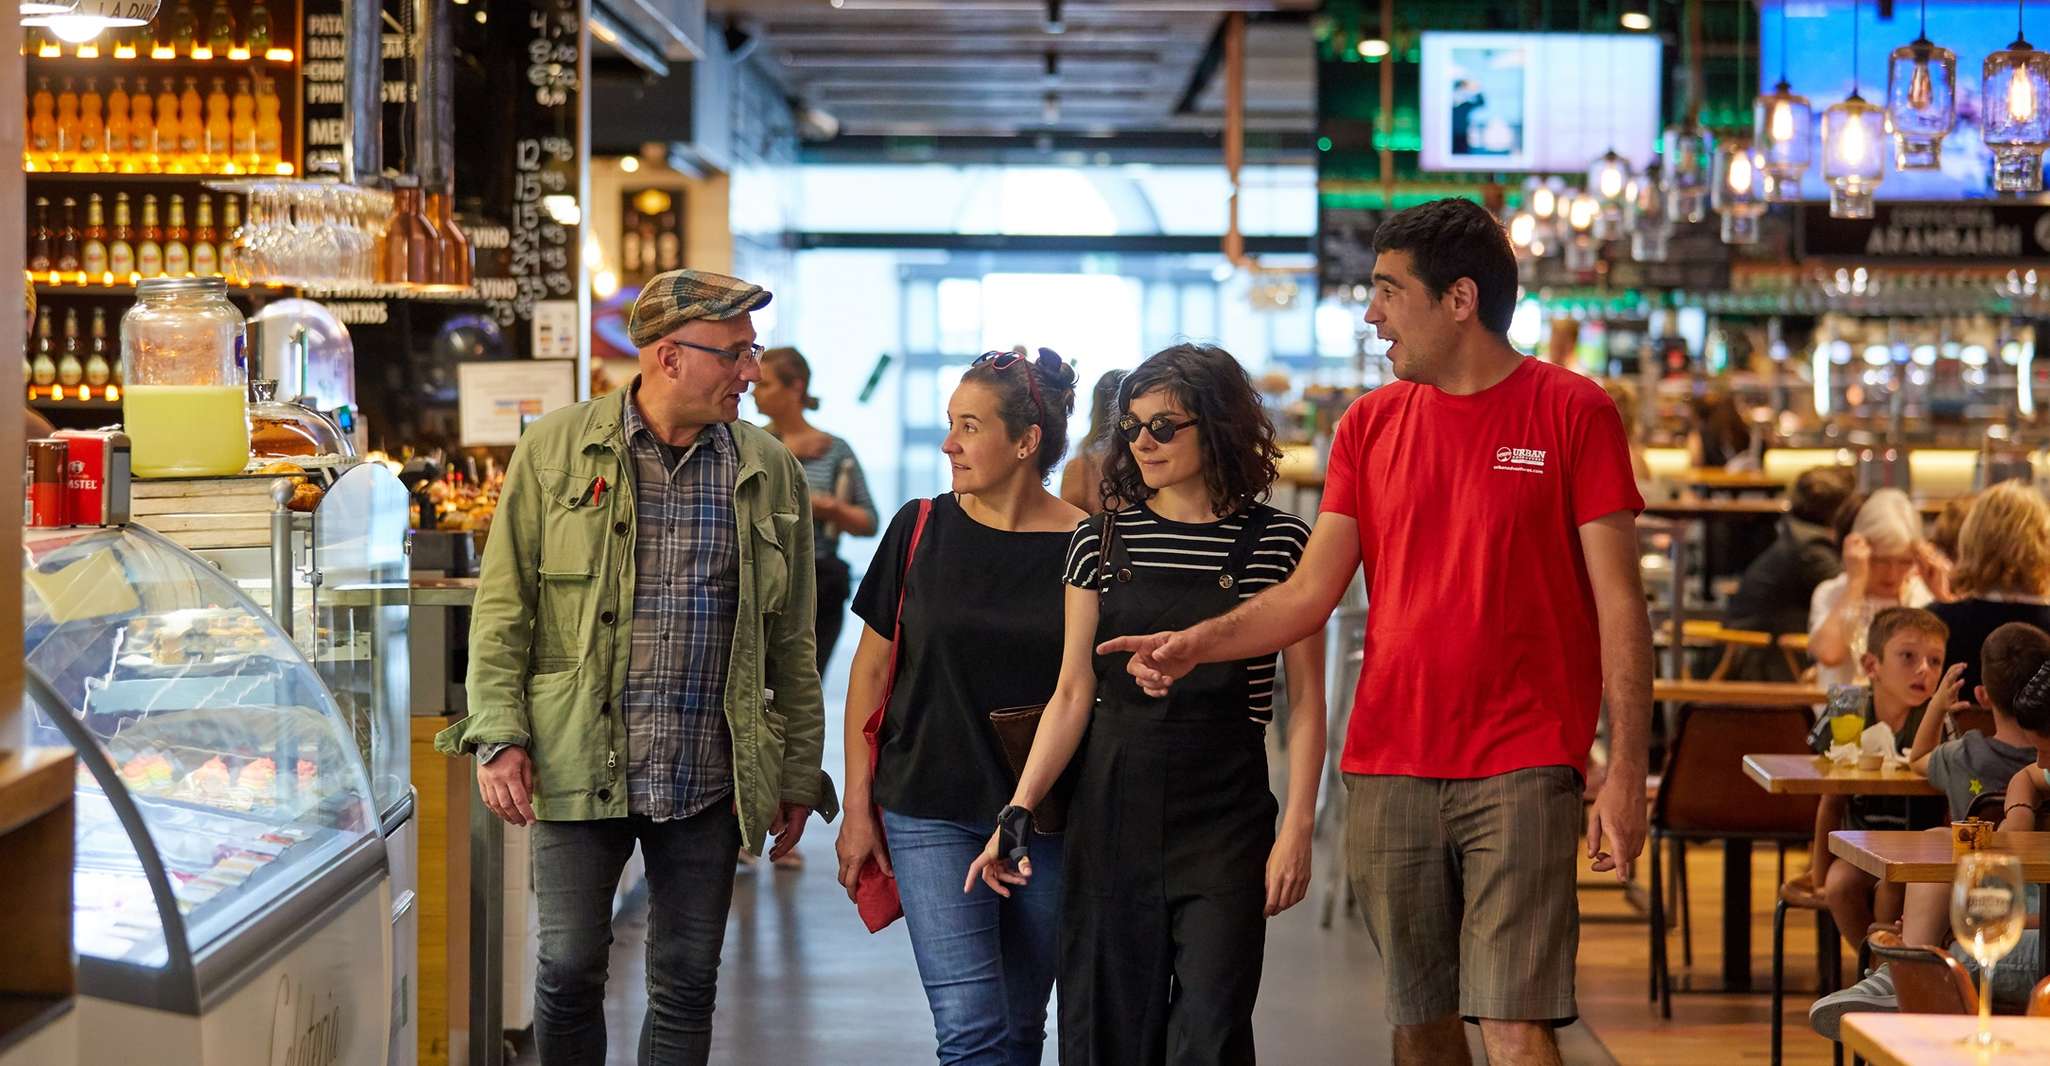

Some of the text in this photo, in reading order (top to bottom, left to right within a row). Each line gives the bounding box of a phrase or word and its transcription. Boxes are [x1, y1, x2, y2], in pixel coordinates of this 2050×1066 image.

[473, 226, 510, 248] VINO
[480, 278, 517, 300] VINO
[1512, 448, 1546, 459] URBAN
